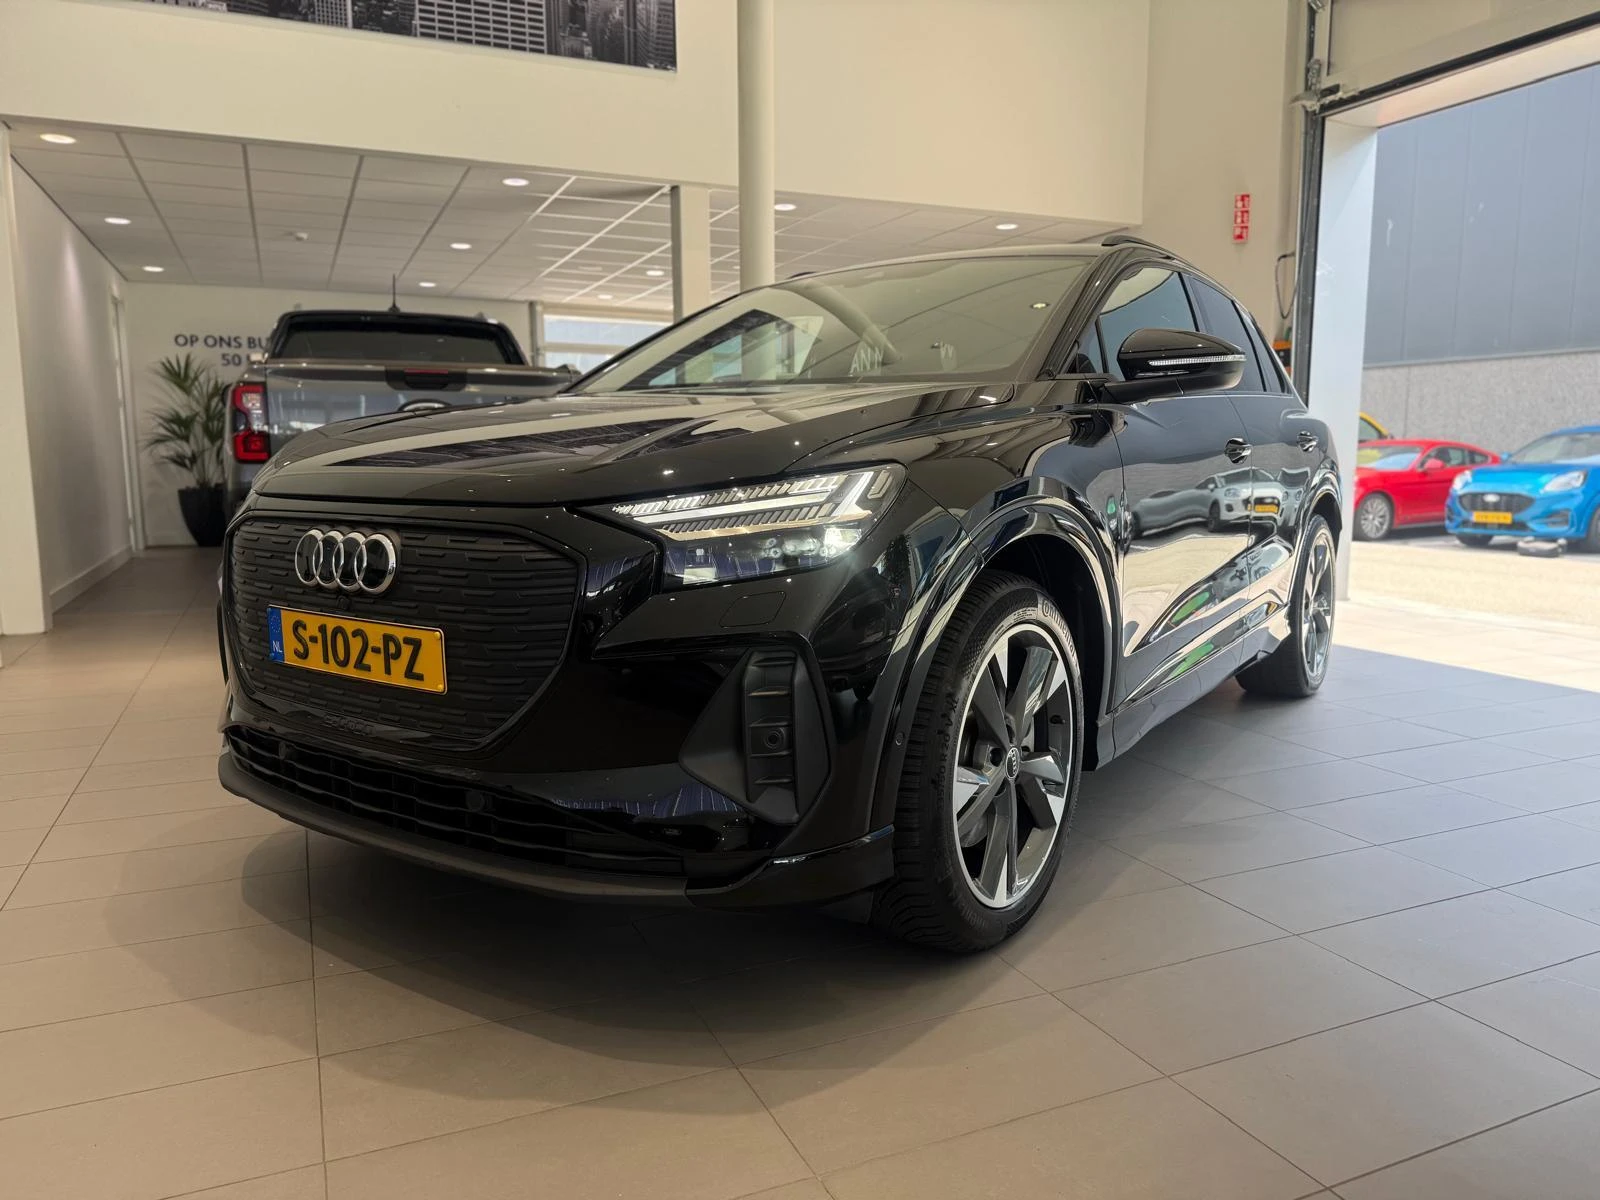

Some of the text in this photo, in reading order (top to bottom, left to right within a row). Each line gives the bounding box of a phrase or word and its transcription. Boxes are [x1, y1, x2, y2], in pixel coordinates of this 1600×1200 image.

[174, 334, 199, 347] OP
[204, 335, 242, 348] ONS
[221, 353, 241, 366] 50
[272, 640, 283, 653] NL
[292, 619, 425, 681] S-102-PZ
